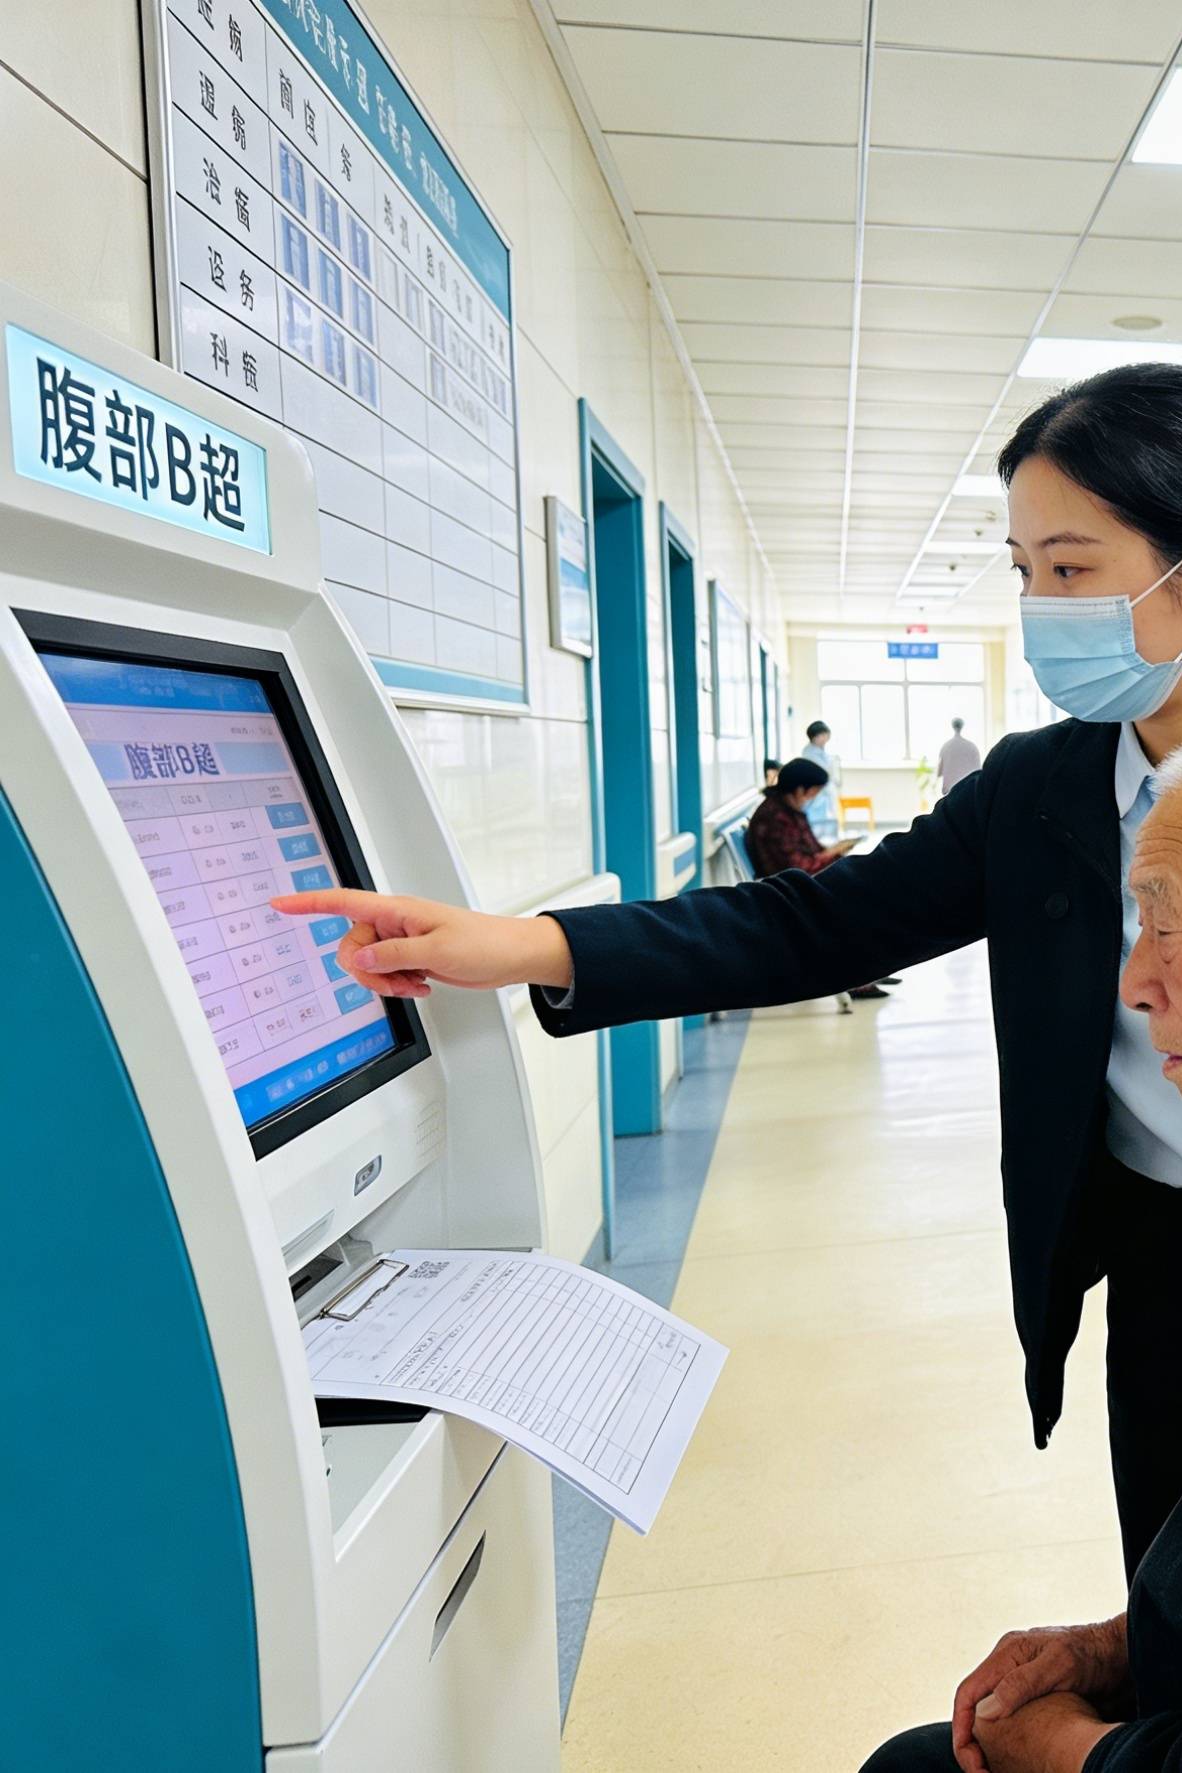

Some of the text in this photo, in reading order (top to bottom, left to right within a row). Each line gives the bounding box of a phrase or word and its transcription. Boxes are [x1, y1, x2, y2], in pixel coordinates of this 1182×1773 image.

[36, 356, 246, 532] 腹部B超
[124, 742, 220, 781] 腹部B超
